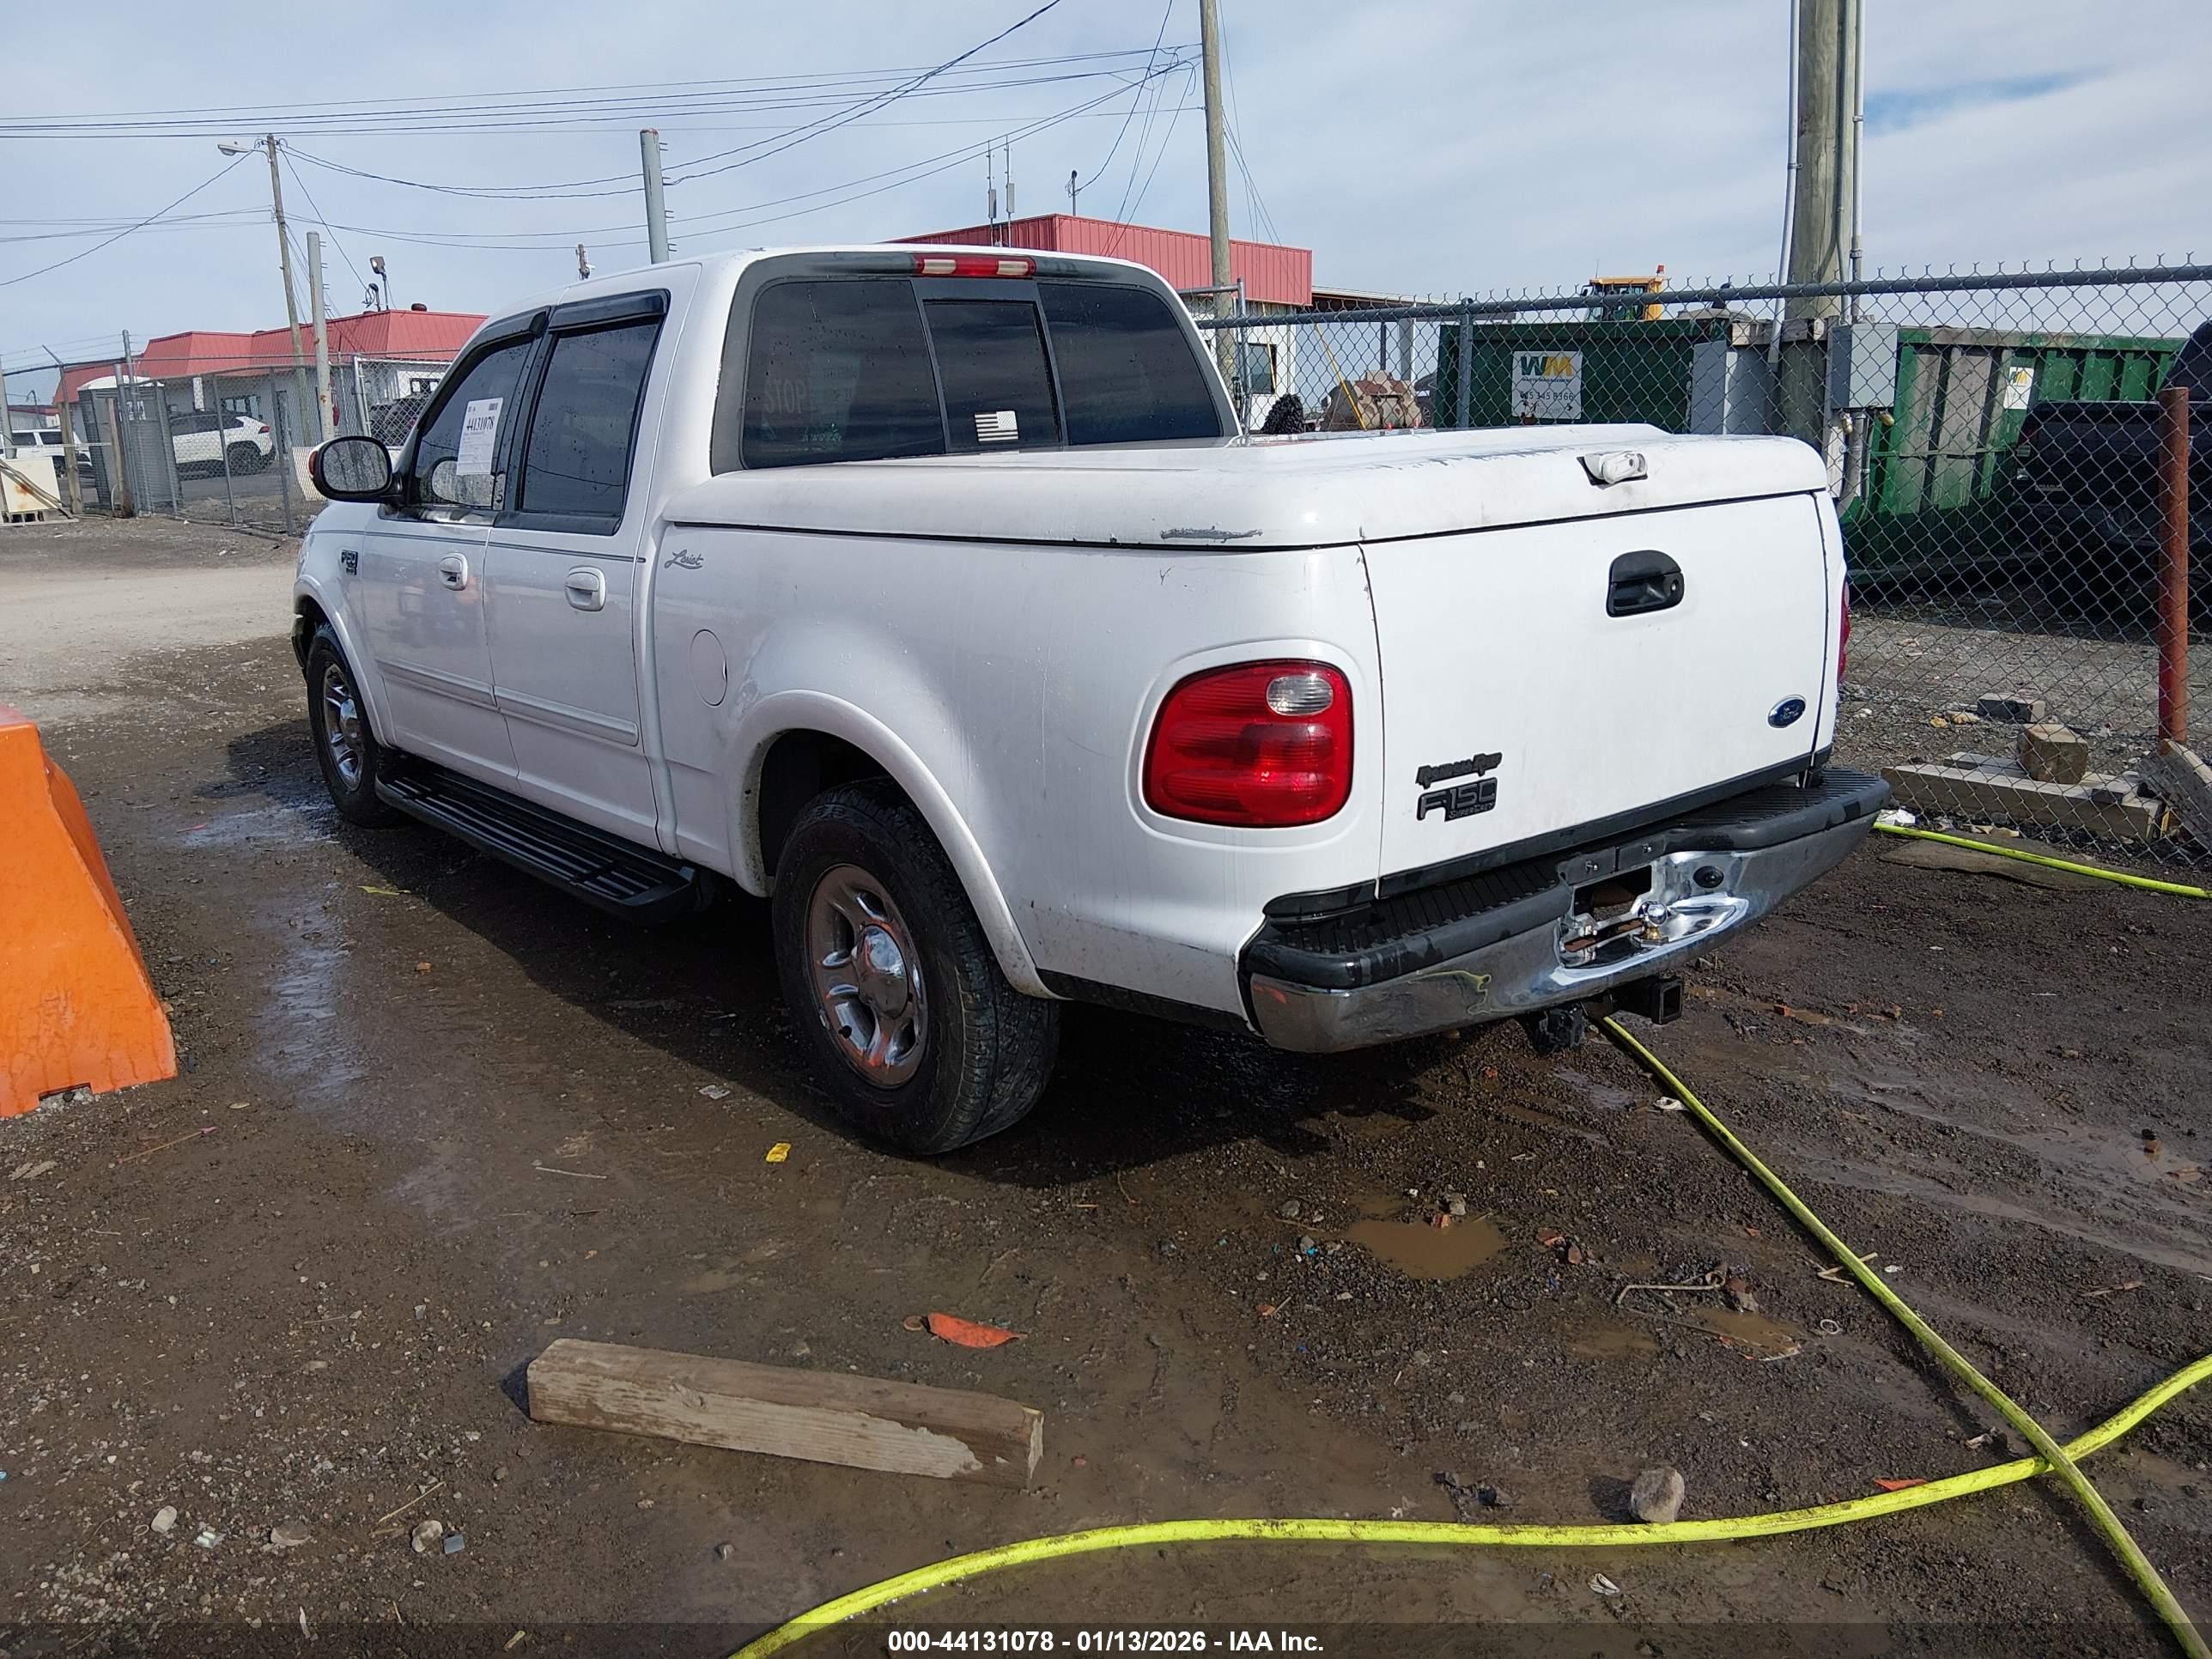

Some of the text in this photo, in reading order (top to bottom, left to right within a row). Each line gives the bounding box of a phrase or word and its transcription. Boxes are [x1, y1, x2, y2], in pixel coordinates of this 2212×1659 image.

[1521, 356, 1572, 376] WM
[764, 378, 805, 414] STOP
[466, 416, 495, 431] 44131078
